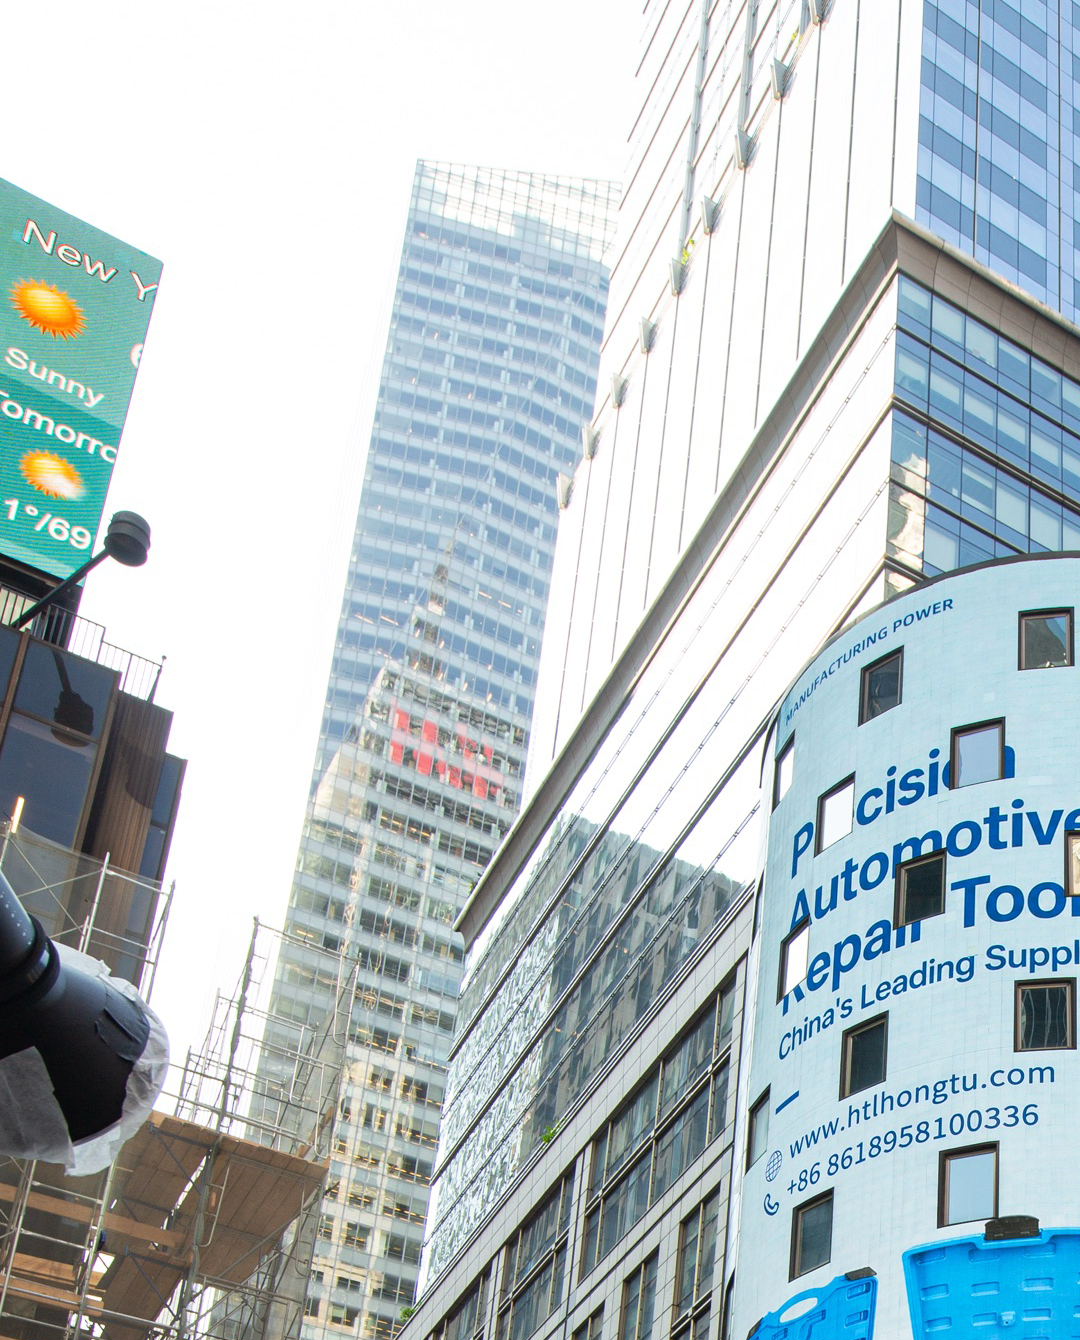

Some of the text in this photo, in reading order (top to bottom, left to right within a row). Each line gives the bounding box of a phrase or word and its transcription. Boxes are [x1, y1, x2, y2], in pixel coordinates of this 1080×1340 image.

[21, 218, 119, 284] New
[3, 346, 106, 408] Sunny
[785, 598, 954, 727] MANUFACTURING POWER
[791, 746, 1015, 880] Pcisi
[778, 995, 853, 1060] China's
[861, 953, 977, 1009] Leading
[786, 1103, 1039, 1195] +86 8618958100336
[788, 1064, 1056, 1159] www.htlhongtu.com
